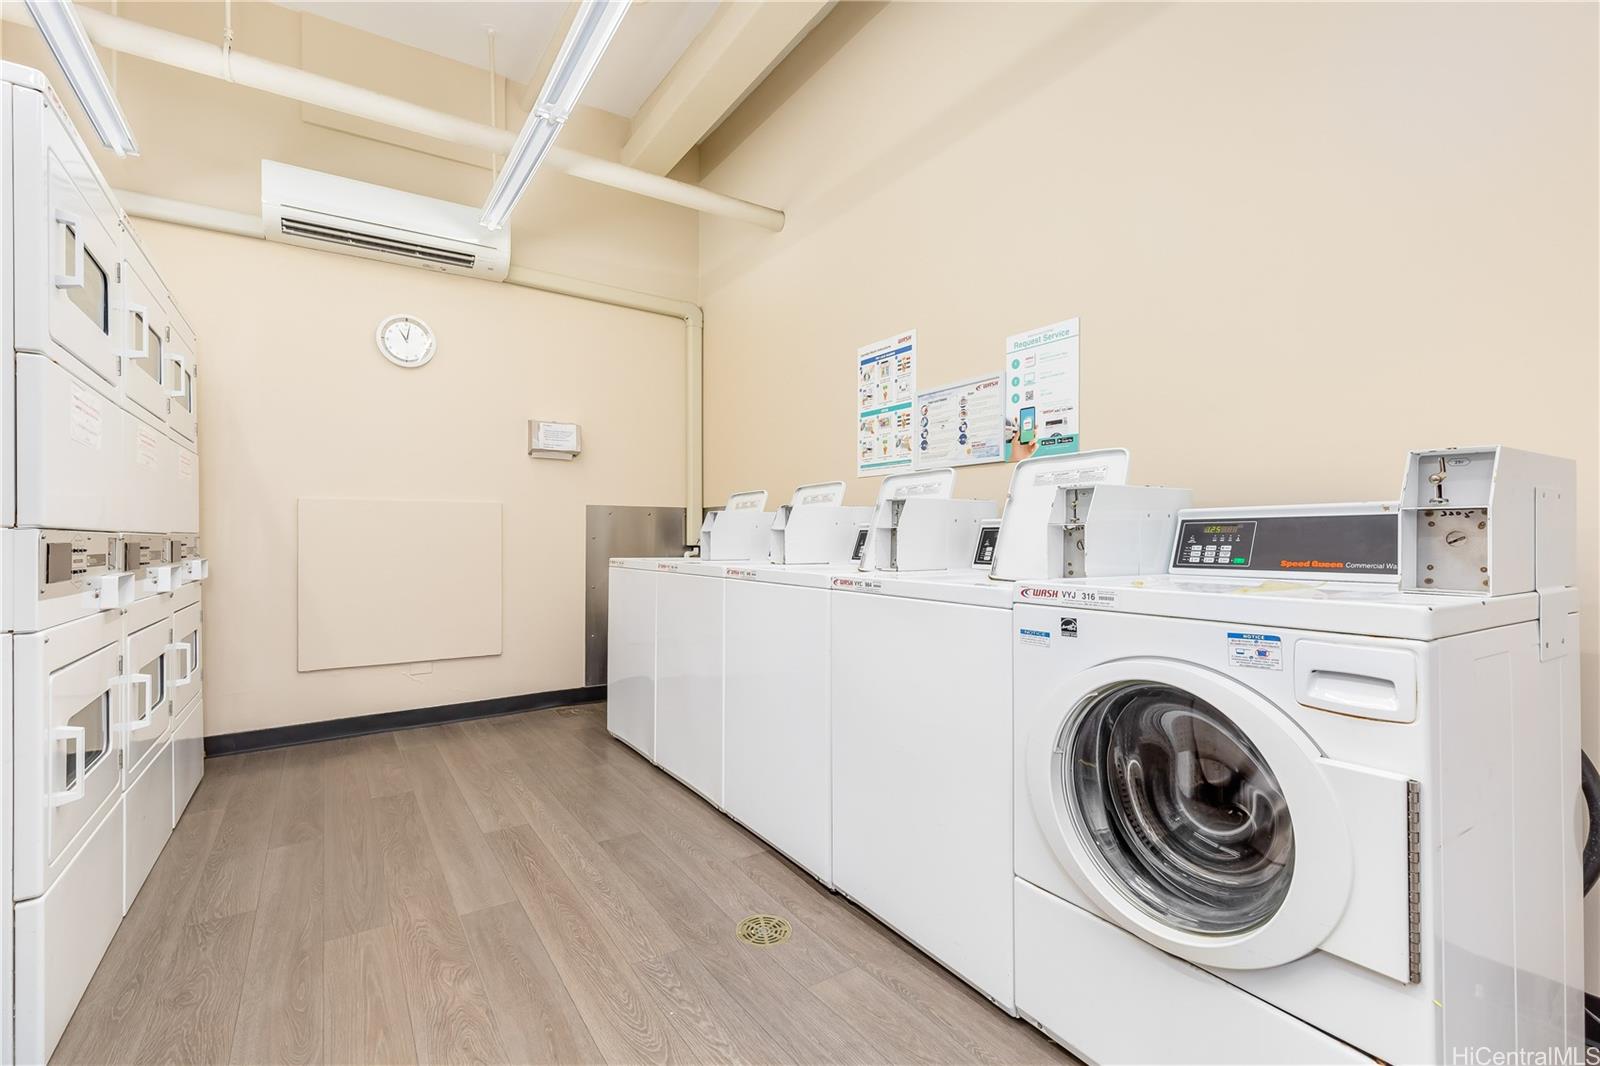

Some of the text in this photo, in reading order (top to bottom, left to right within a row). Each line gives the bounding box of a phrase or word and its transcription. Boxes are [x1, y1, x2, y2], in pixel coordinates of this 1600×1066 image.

[1014, 336, 1041, 351] Request
[1042, 329, 1070, 343] Service
[1280, 560, 1311, 569] Speed
[1311, 560, 1344, 569] Queen
[1033, 588, 1058, 598] WASH
[1061, 591, 1077, 600] VYJ
[1081, 592, 1096, 601] 316
[1242, 633, 1265, 641] NOTICE
